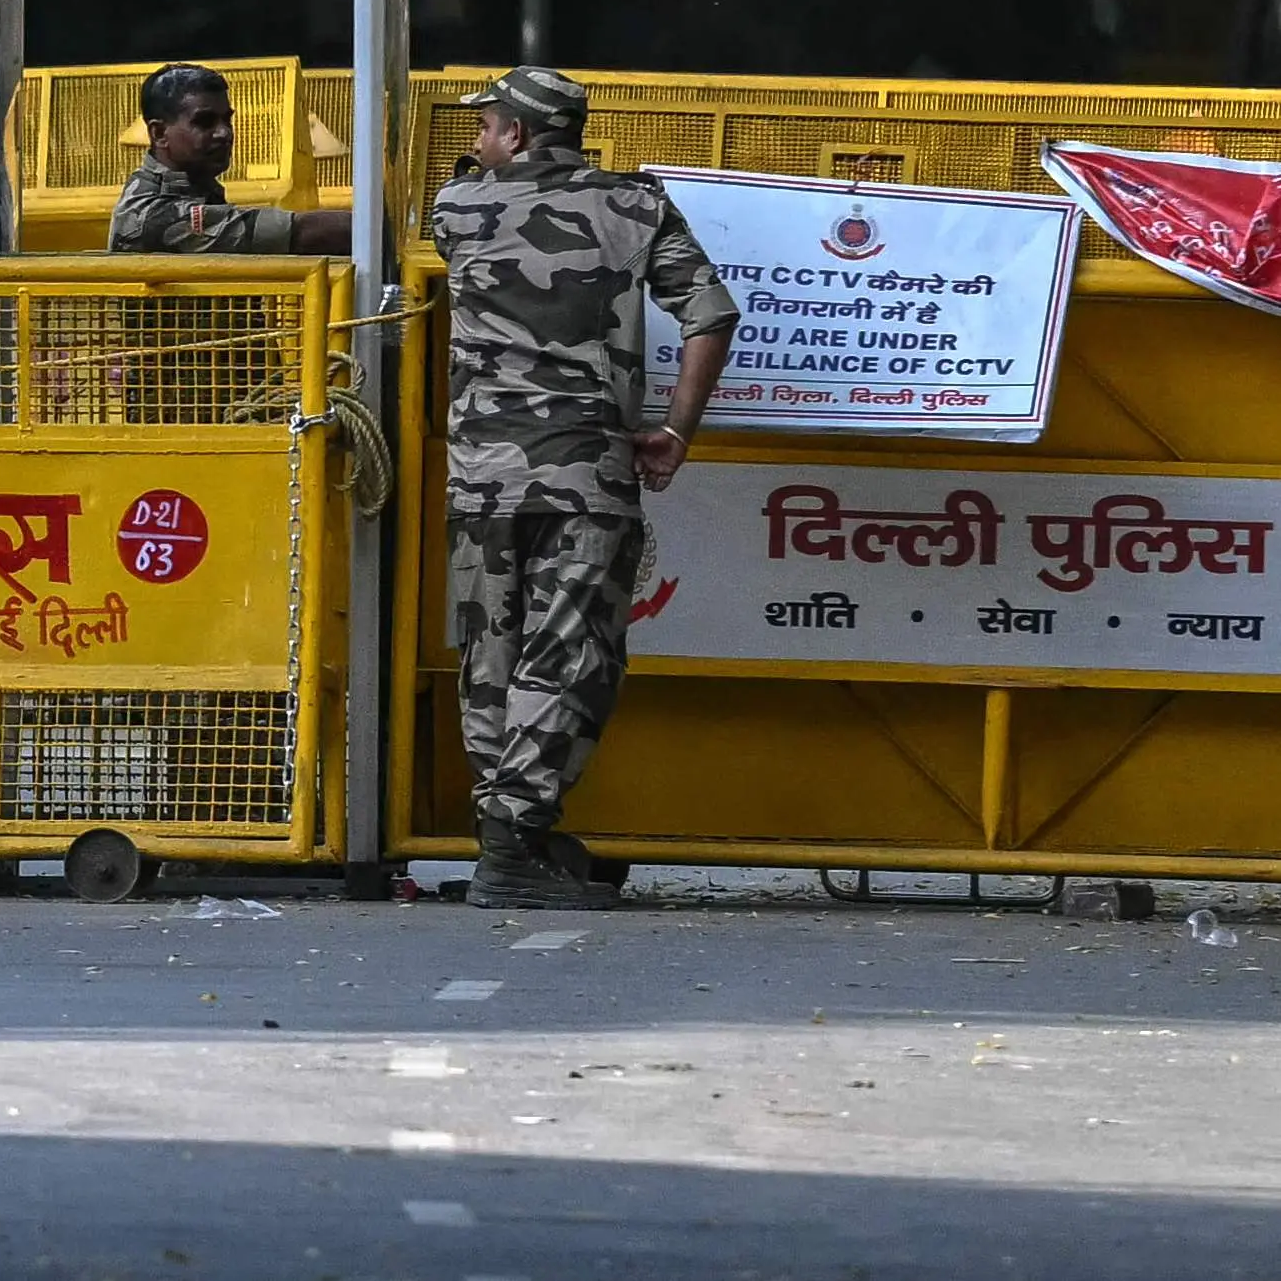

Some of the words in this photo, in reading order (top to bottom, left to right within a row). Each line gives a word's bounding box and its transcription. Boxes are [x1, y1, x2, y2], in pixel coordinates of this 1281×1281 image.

[770, 266, 863, 289] CCTV
[866, 269, 949, 295] कैमरे
[951, 274, 997, 296] की
[745, 290, 875, 320] निगरानी
[880, 300, 915, 322] में
[916, 301, 942, 324] है
[738, 324, 779, 344] OU
[788, 327, 847, 347] ARE
[857, 330, 958, 351] UNDER
[888, 357, 927, 375] OF
[935, 358, 1015, 376] CCTV
[849, 387, 914, 405] दिल्ली
[921, 389, 989, 410] पुलिस
[130, 498, 181, 530] D-21
[761, 484, 1006, 567] दिल्ली
[1026, 493, 1274, 593] पुलिस
[134, 541, 174, 577] 63
[33, 591, 130, 657] दिल्ली
[976, 598, 1057, 635] सेवा
[1167, 613, 1266, 642] न्याय
